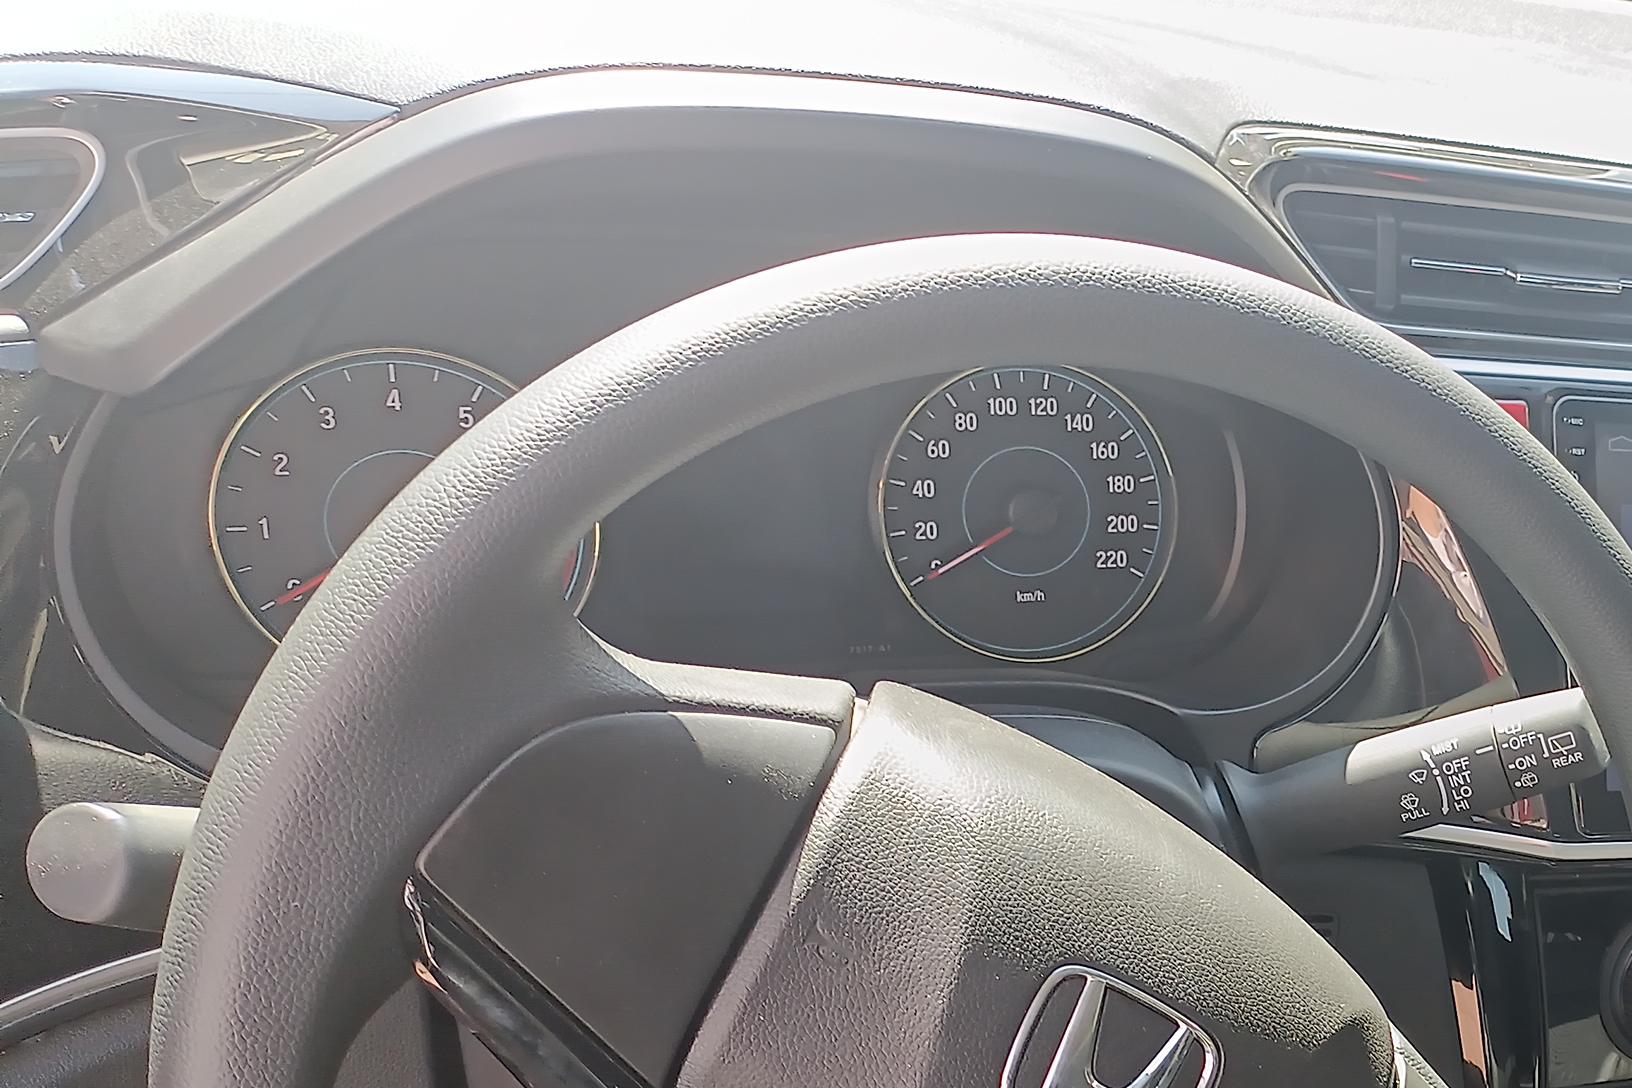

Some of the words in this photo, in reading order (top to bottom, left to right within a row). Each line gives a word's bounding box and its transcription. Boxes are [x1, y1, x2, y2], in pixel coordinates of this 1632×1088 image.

[386, 388, 402, 411] 4
[987, 397, 1017, 416] 100
[1028, 397, 1058, 416] 120
[319, 406, 336, 430] 3
[458, 406, 475, 429] 5
[954, 412, 978, 432] 80
[1064, 413, 1094, 433] 140
[926, 439, 951, 459] 60
[1090, 442, 1119, 460] 160
[272, 453, 291, 477] 2
[912, 479, 936, 498] 40
[1106, 475, 1135, 493] 180
[257, 516, 270, 540] 1
[914, 521, 939, 541] 20
[1107, 515, 1138, 533] 200
[1095, 550, 1128, 569] 220
[1016, 590, 1046, 602] km/h
[1431, 738, 1459, 758] MIST
[1508, 731, 1538, 751] OFF
[1442, 756, 1471, 776] OFF
[1515, 753, 1538, 771] ON
[1551, 751, 1584, 769] REAR
[1448, 771, 1472, 788] INT
[1452, 785, 1473, 801] LO
[1400, 807, 1431, 823] PULL
[1455, 800, 1471, 812] HI
